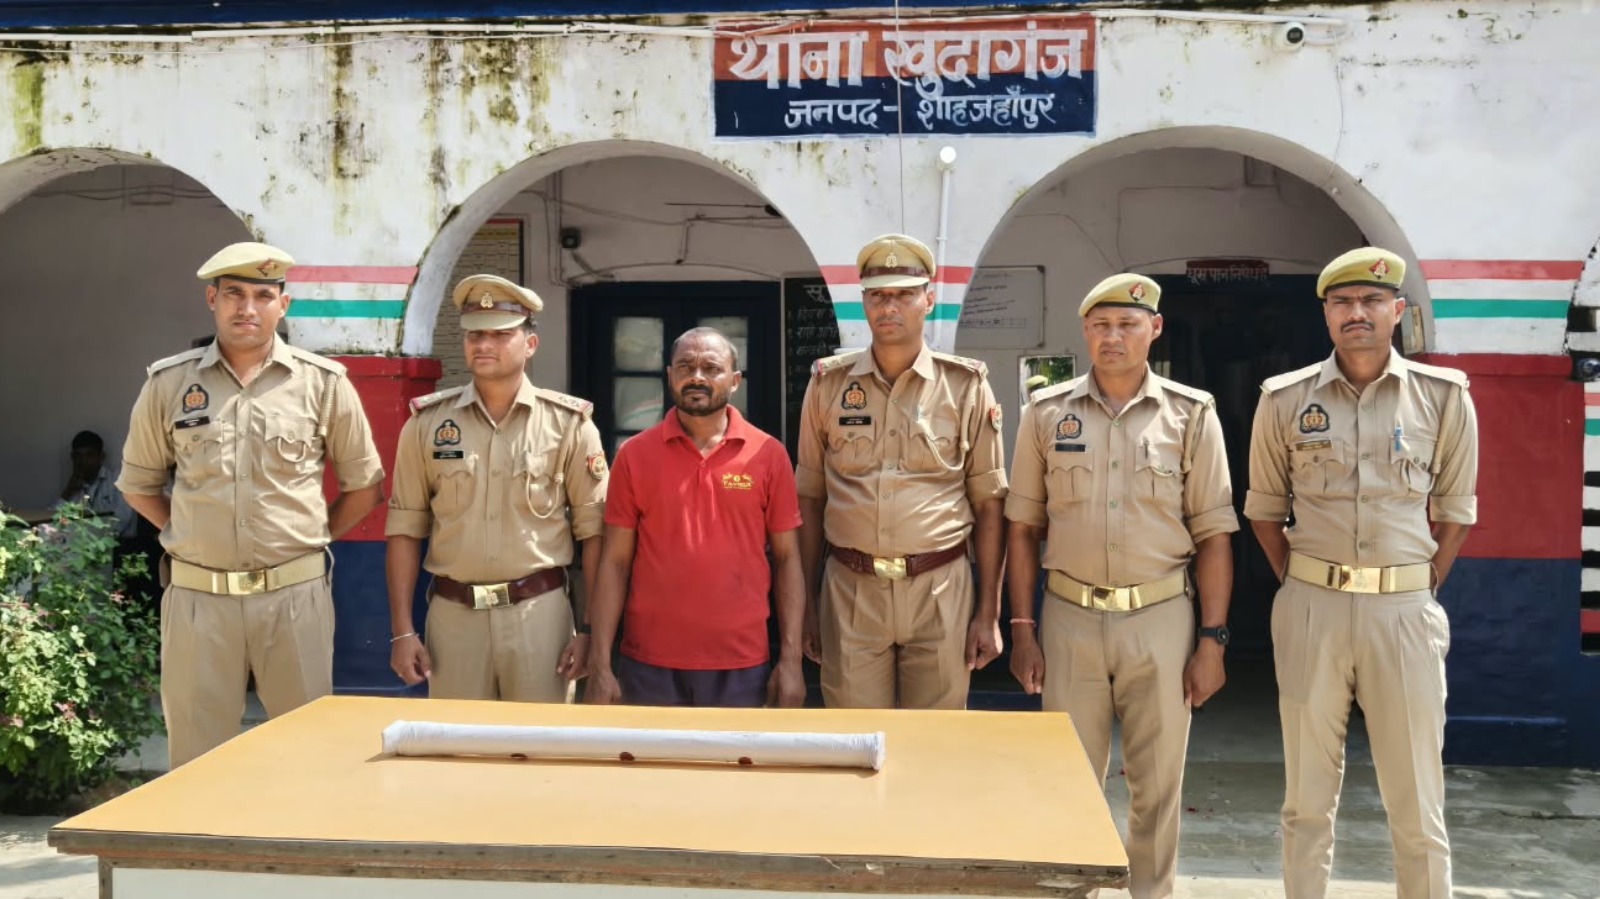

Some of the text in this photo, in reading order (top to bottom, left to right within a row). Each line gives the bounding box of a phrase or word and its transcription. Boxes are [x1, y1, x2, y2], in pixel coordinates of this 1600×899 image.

[729, 20, 1088, 99] थाना खुदागंज
[916, 85, 1056, 130] शाहजहाँपुर
